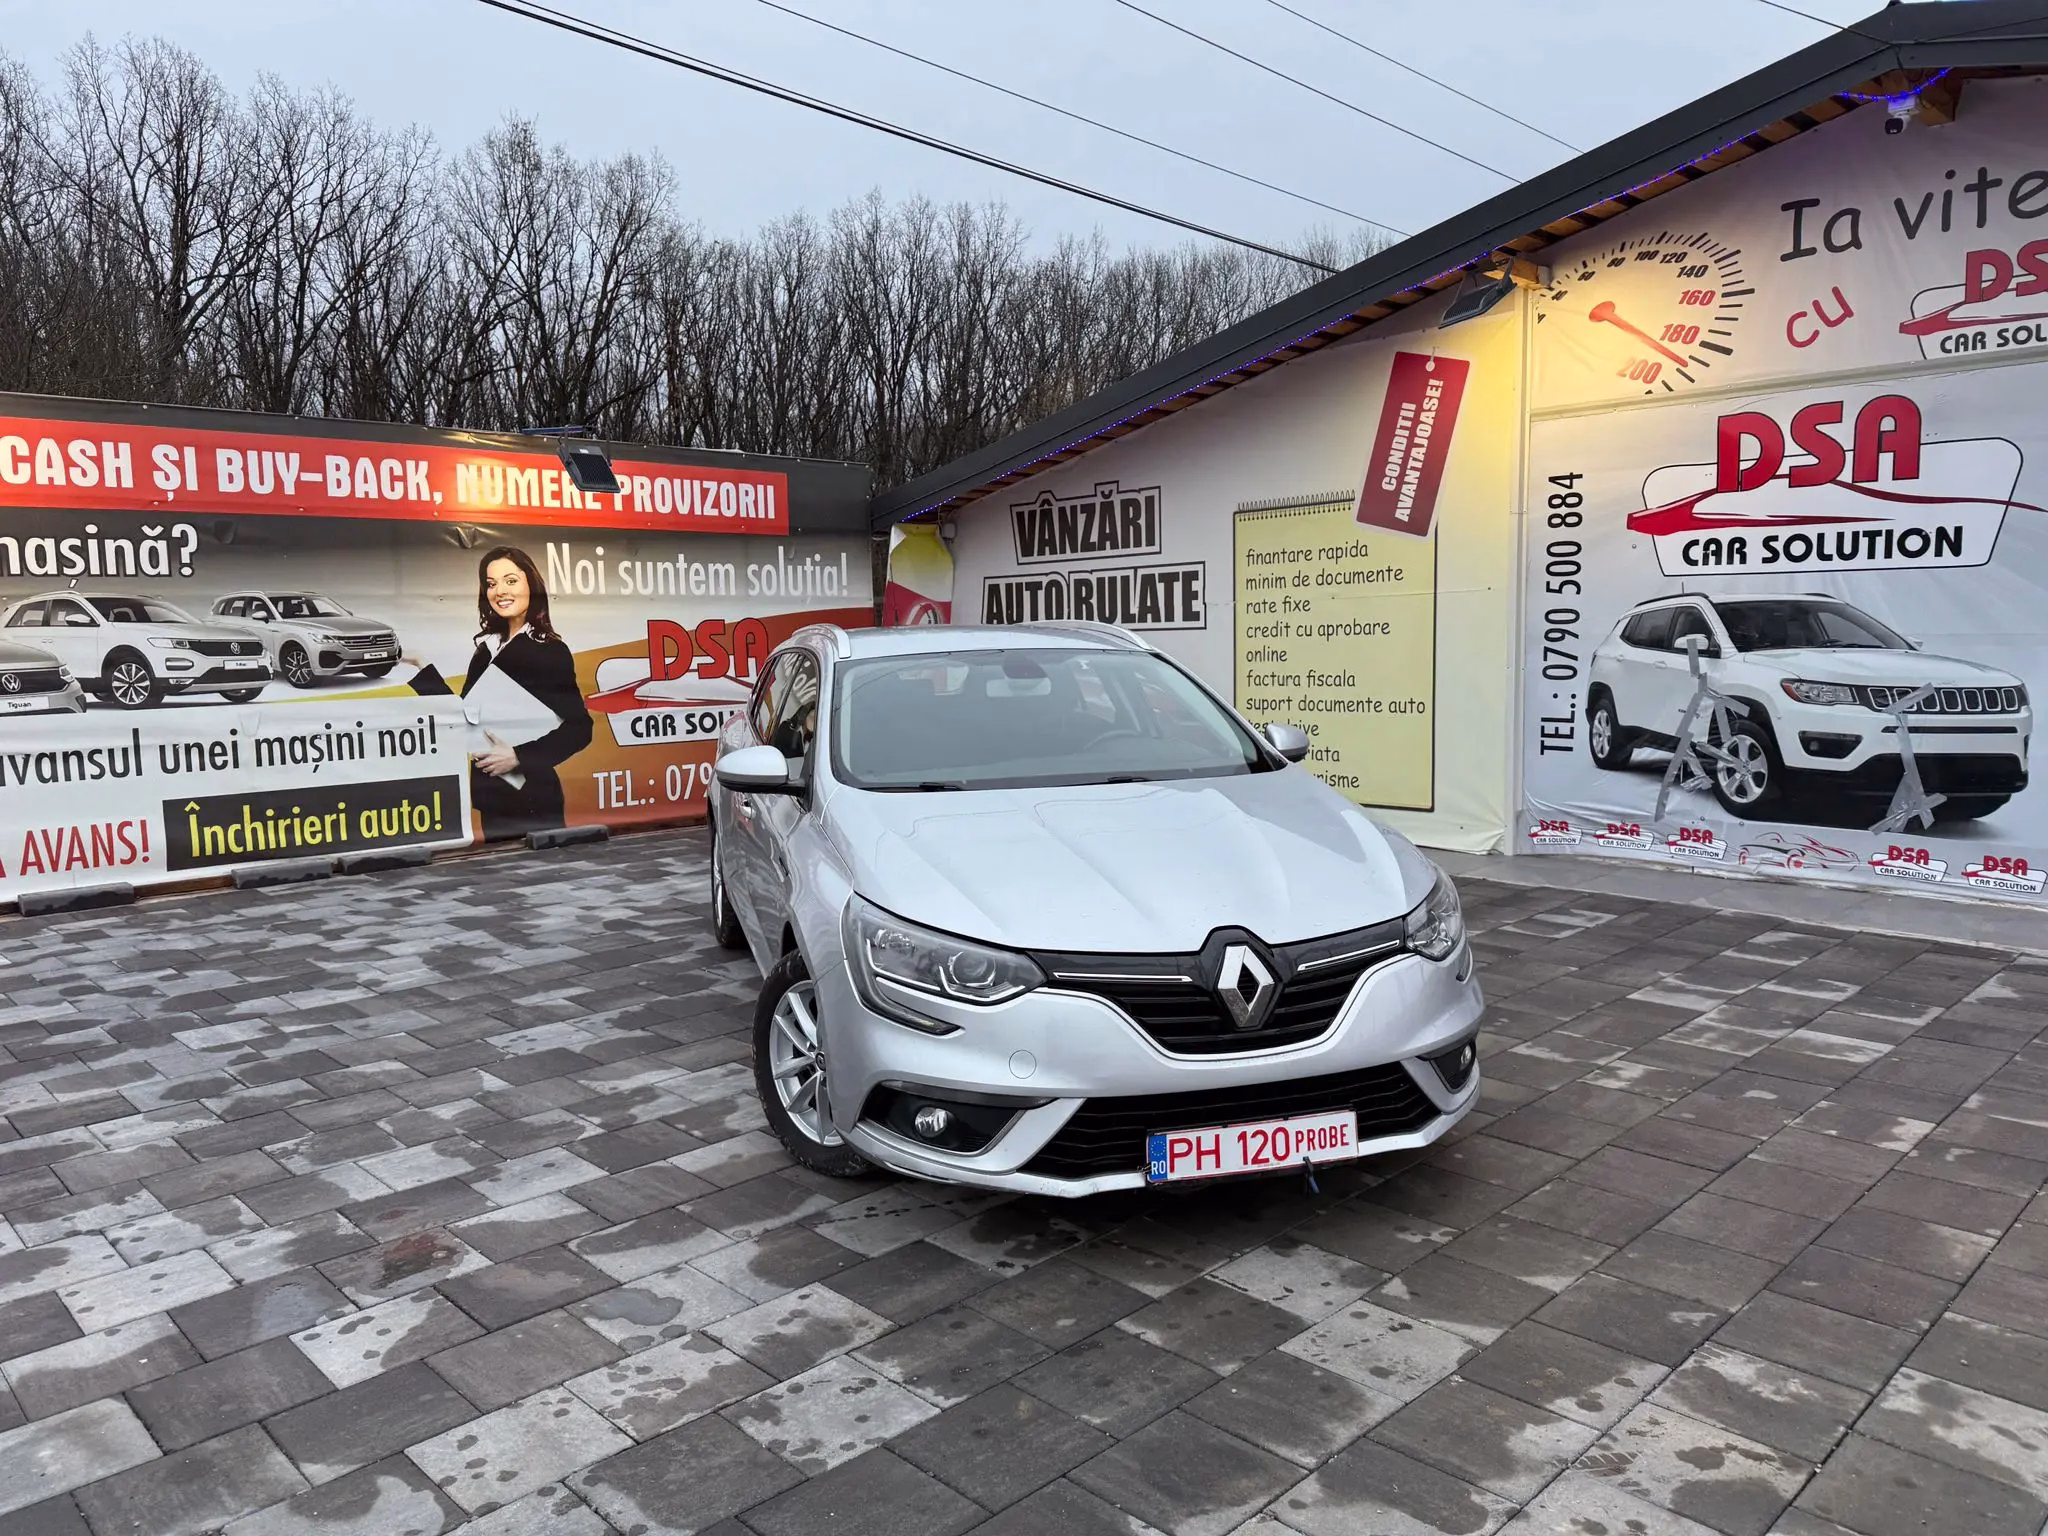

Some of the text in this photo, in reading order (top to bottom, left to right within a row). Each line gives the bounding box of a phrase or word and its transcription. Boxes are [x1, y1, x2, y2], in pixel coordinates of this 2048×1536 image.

[1780, 198, 1862, 262] Ia
[1634, 250, 1659, 261] 100
[1660, 251, 1688, 264] 120
[1676, 264, 1709, 278] 140
[1678, 289, 1716, 306] 160
[1786, 286, 1854, 348] cu
[1659, 323, 1700, 345] 180
[1940, 331, 1987, 354] CAR
[1616, 356, 1662, 384] 200
[1381, 402, 1417, 492] CONDITII
[1394, 378, 1444, 523] AVANTAJOASE!
[1716, 394, 1922, 493] DSA
[0, 435, 134, 489] CASH
[151, 443, 199, 502] ȘI
[215, 447, 444, 505] BUY-BACK,
[614, 475, 776, 520] PROVIZORII
[1015, 489, 1156, 558] VÂNZĂRI
[1246, 539, 1369, 567] finantare rapida
[1682, 525, 1964, 567] CAR SOLUTION
[546, 542, 605, 596] Noi
[618, 553, 736, 597] suntem
[1245, 565, 1404, 591] minim de documente
[986, 570, 1201, 624] AUTO RULATE
[1246, 595, 1312, 614] rate fixe
[1540, 472, 1584, 756] TEL.: 0790 500 884
[1246, 618, 1391, 642] credit cu aprobare
[647, 618, 770, 682] DSA
[1246, 645, 1288, 663] online
[1246, 669, 1356, 688] factura fiscala
[7, 701, 32, 709] Tiguan
[1246, 694, 1426, 715] suport documente auto
[630, 713, 677, 738] CAR
[159, 728, 240, 775] unei
[254, 722, 365, 774] mașini
[378, 714, 438, 758] noi!
[592, 770, 656, 810] TEL.:
[184, 790, 443, 858] Închirieri auto!
[1679, 827, 1714, 844] DSA
[19, 819, 150, 876] AVANS!
[1687, 848, 1720, 858] SOLUTION
[1888, 845, 1930, 866] DSA
[1880, 867, 1937, 881] CAR SOLUTION
[1983, 855, 2028, 876] DSA
[1974, 878, 2037, 892] CAR SOLUTION
[1168, 1123, 1350, 1174] PH 120 PROBE
[1151, 1160, 1166, 1175] RO
